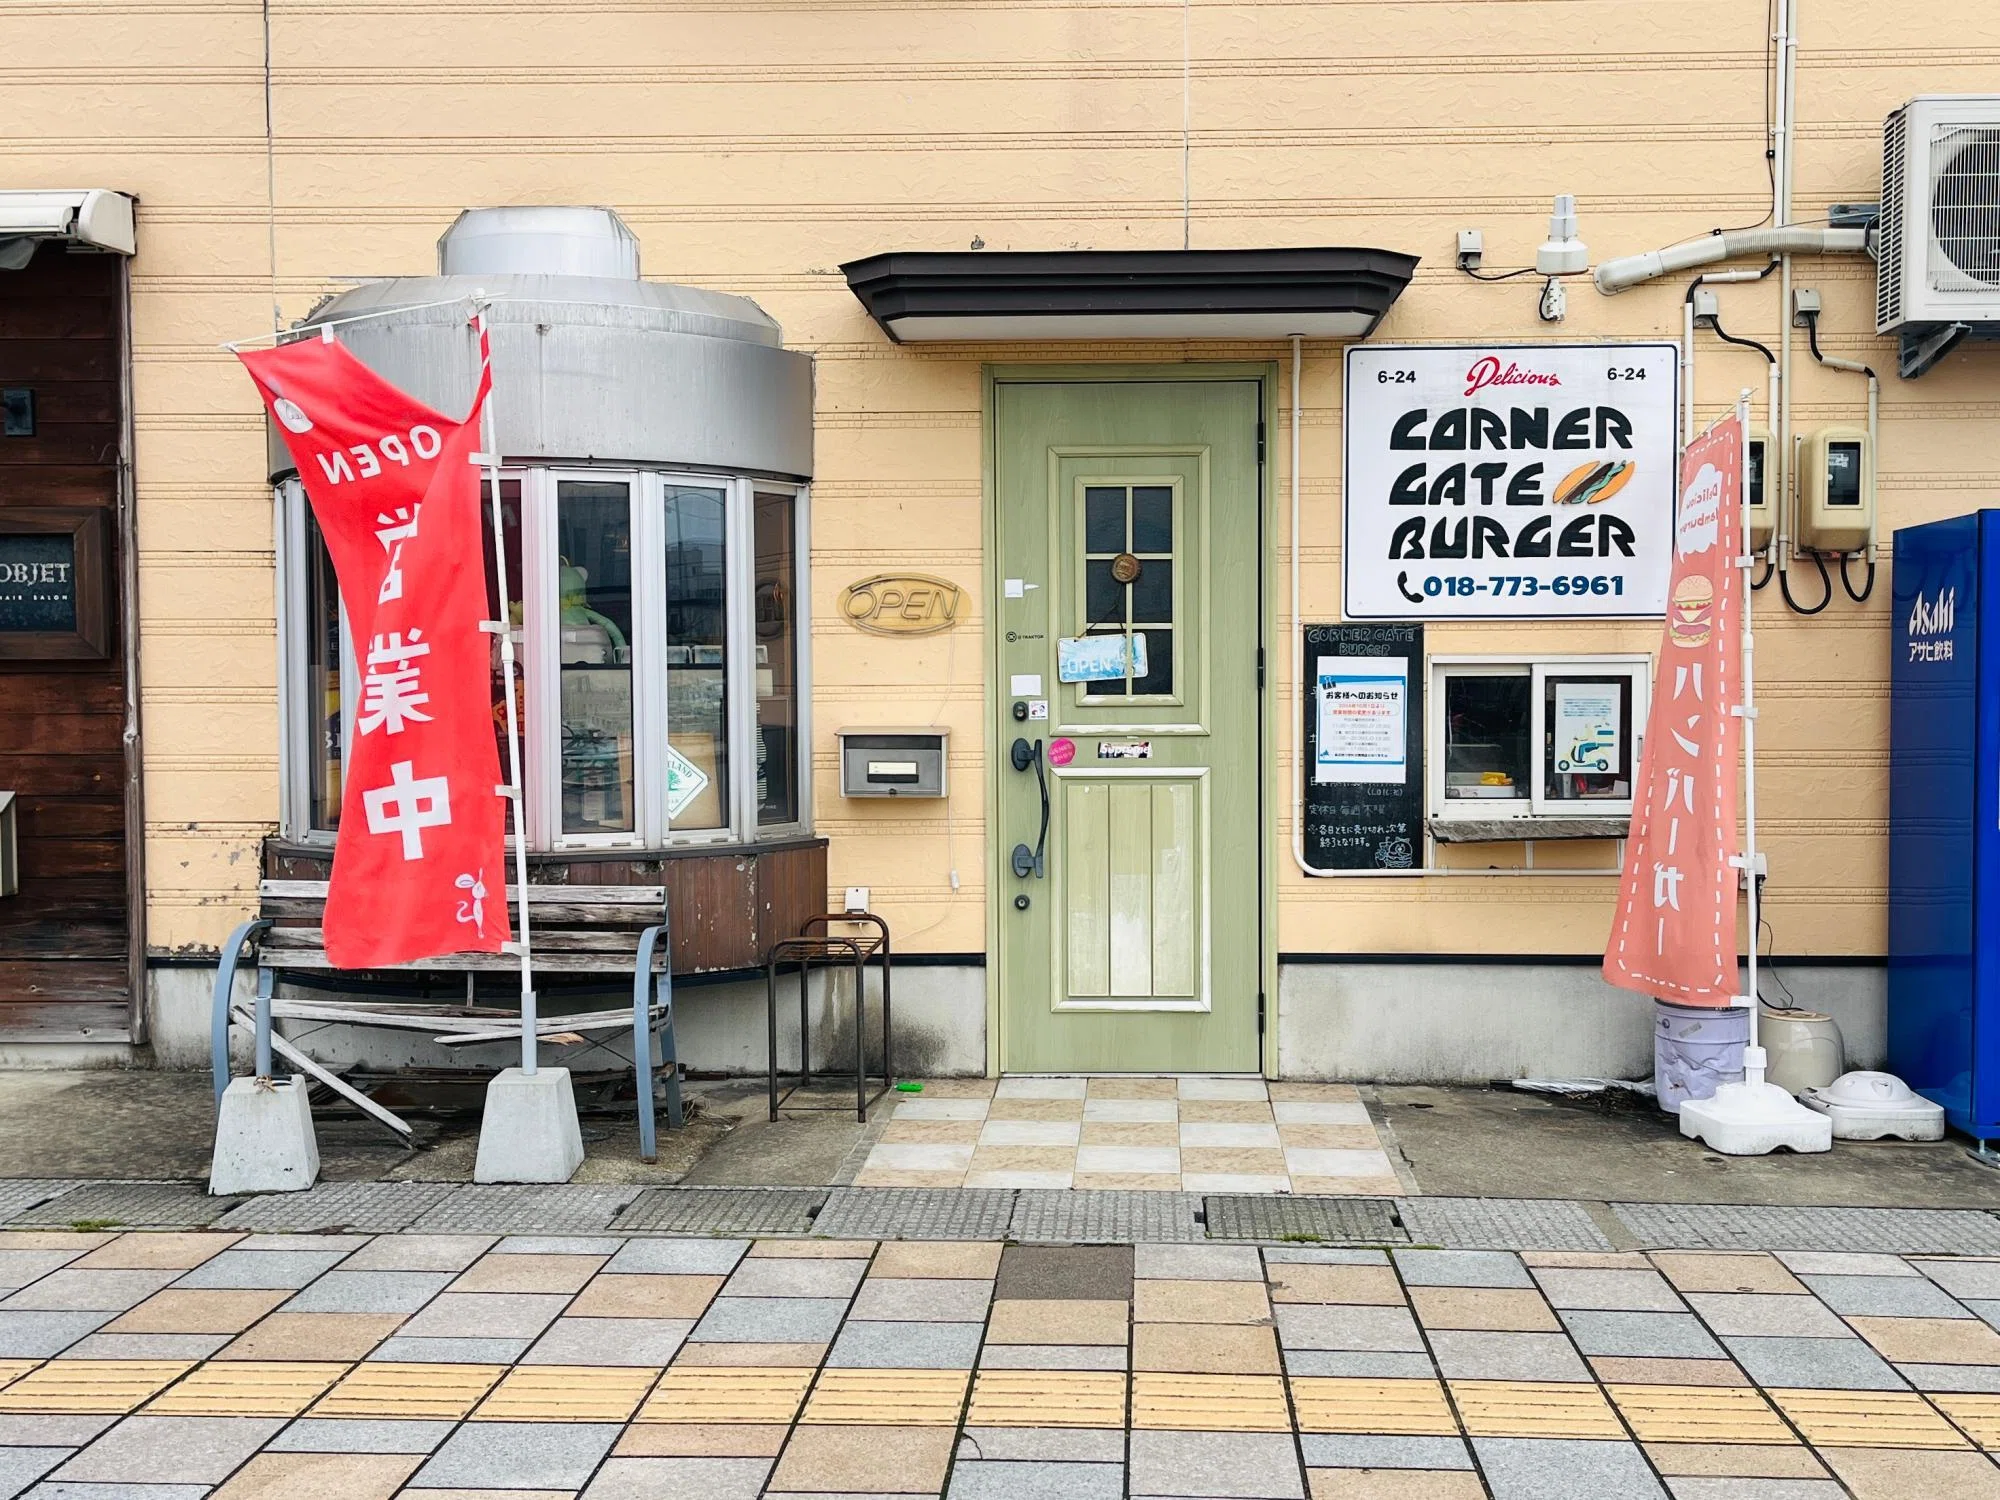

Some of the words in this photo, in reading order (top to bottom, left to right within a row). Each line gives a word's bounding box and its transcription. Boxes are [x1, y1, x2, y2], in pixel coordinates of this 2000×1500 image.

[1378, 370, 1416, 383] 6-24
[1464, 356, 1562, 397] Delicious
[1607, 368, 1646, 381] 6-24
[1389, 406, 1633, 450] CORNER
[1388, 462, 1544, 506] GATE
[1388, 514, 1636, 560] BURGER
[0, 563, 70, 586] OBJET
[1423, 575, 1624, 597] 018-773-6961
[843, 589, 962, 620] OPEN
[1908, 586, 1955, 637] Asahi
[1308, 629, 1371, 643] CORNER
[1374, 629, 1415, 642] GATE
[1339, 643, 1391, 656] BURGER
[1908, 640, 1954, 663] アサヒ飲料
[1067, 657, 1113, 674] OPEN
[1325, 691, 1399, 701] お客様へのお知らせ
